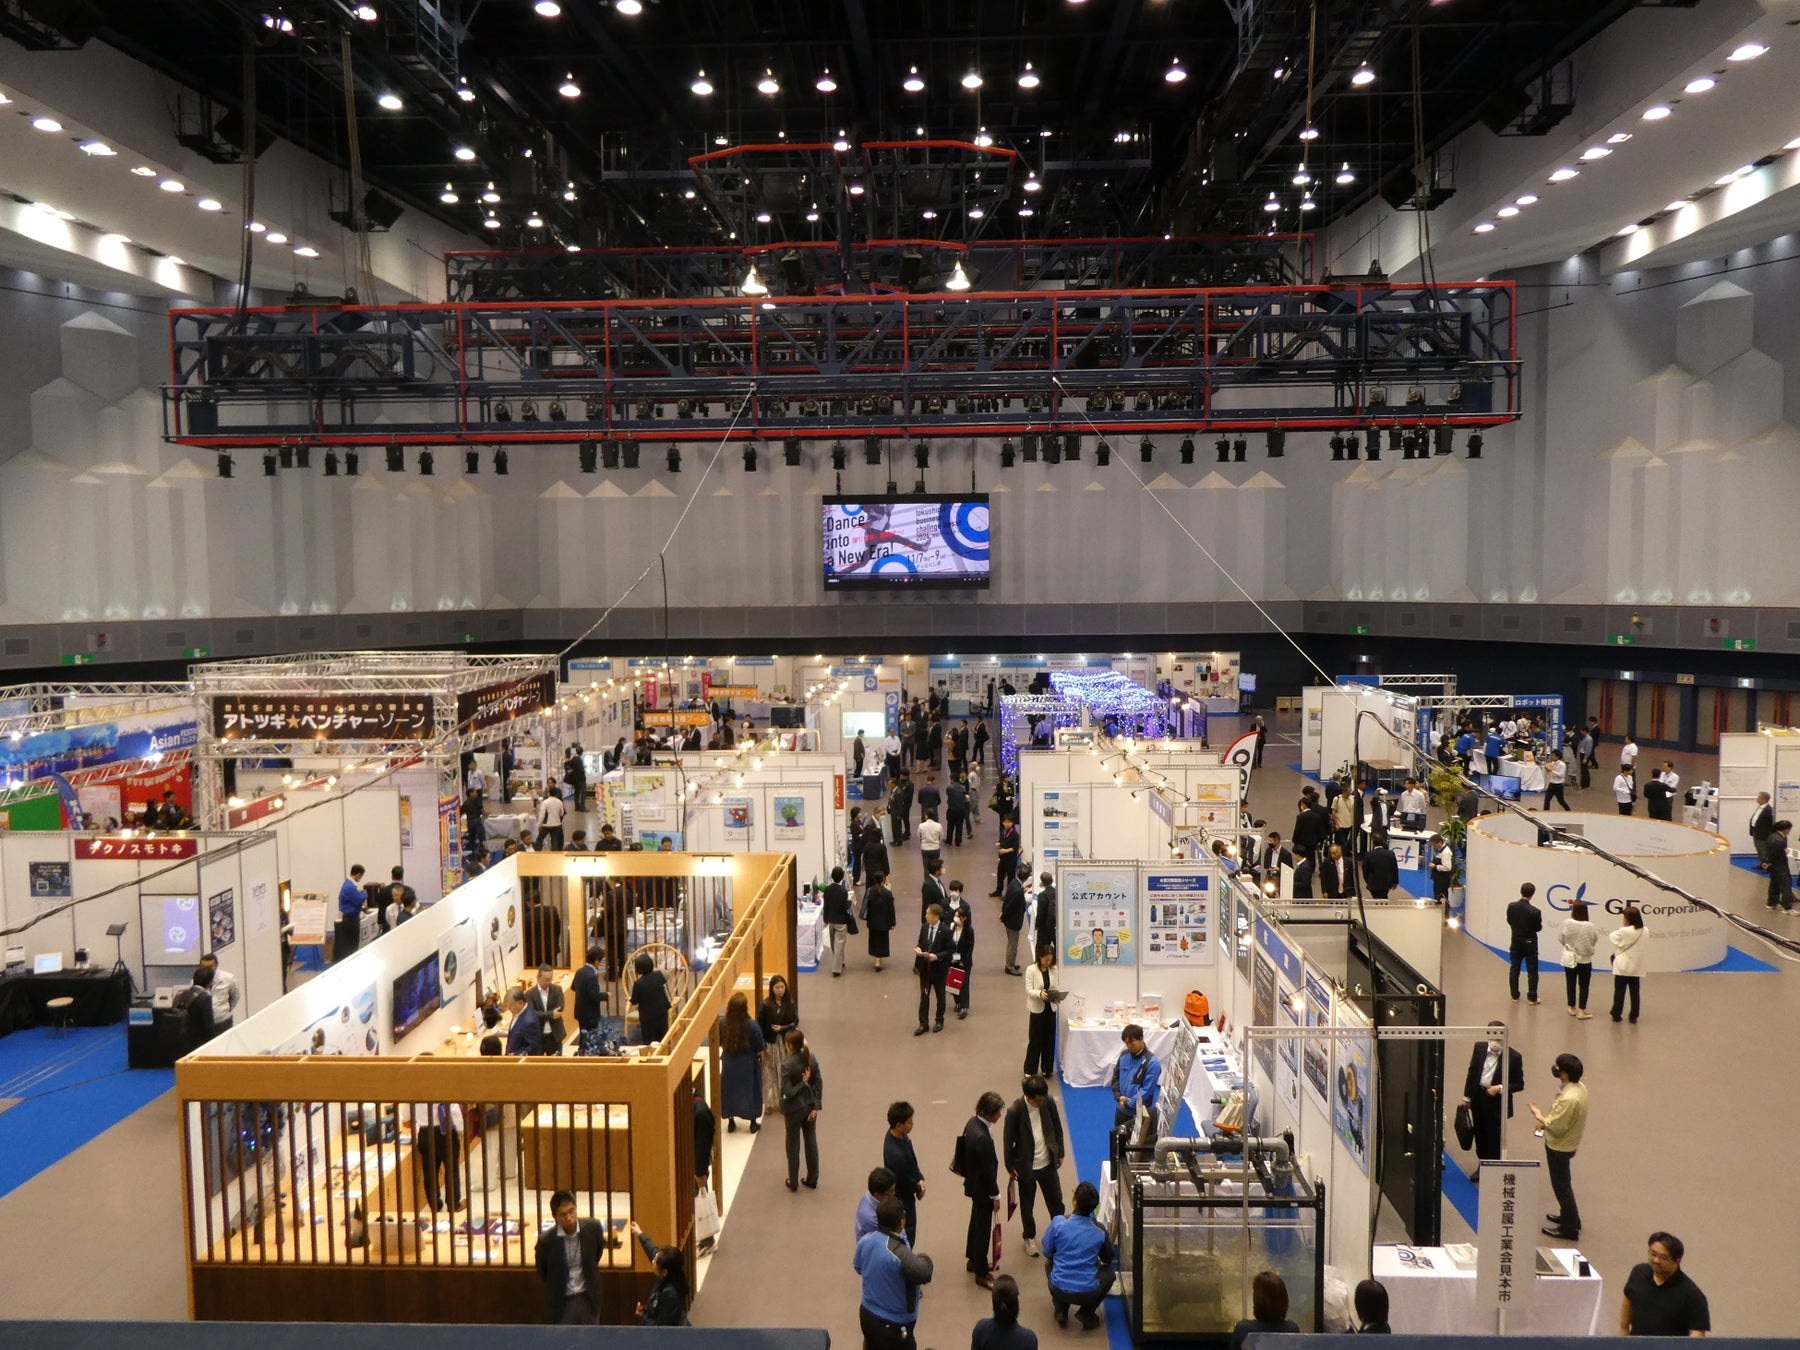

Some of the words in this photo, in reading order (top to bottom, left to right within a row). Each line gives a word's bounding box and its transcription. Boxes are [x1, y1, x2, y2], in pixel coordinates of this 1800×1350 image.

[826, 515, 865, 532] Dance
[826, 533, 850, 550] into
[826, 556, 835, 568] a
[838, 549, 867, 566] New
[150, 733, 181, 751] Asian
[89, 842, 183, 856] テクノスモトキ
[1071, 892, 1127, 900] 公式アカウント
[1498, 1173, 1516, 1302] 機械金属工業会見本市
